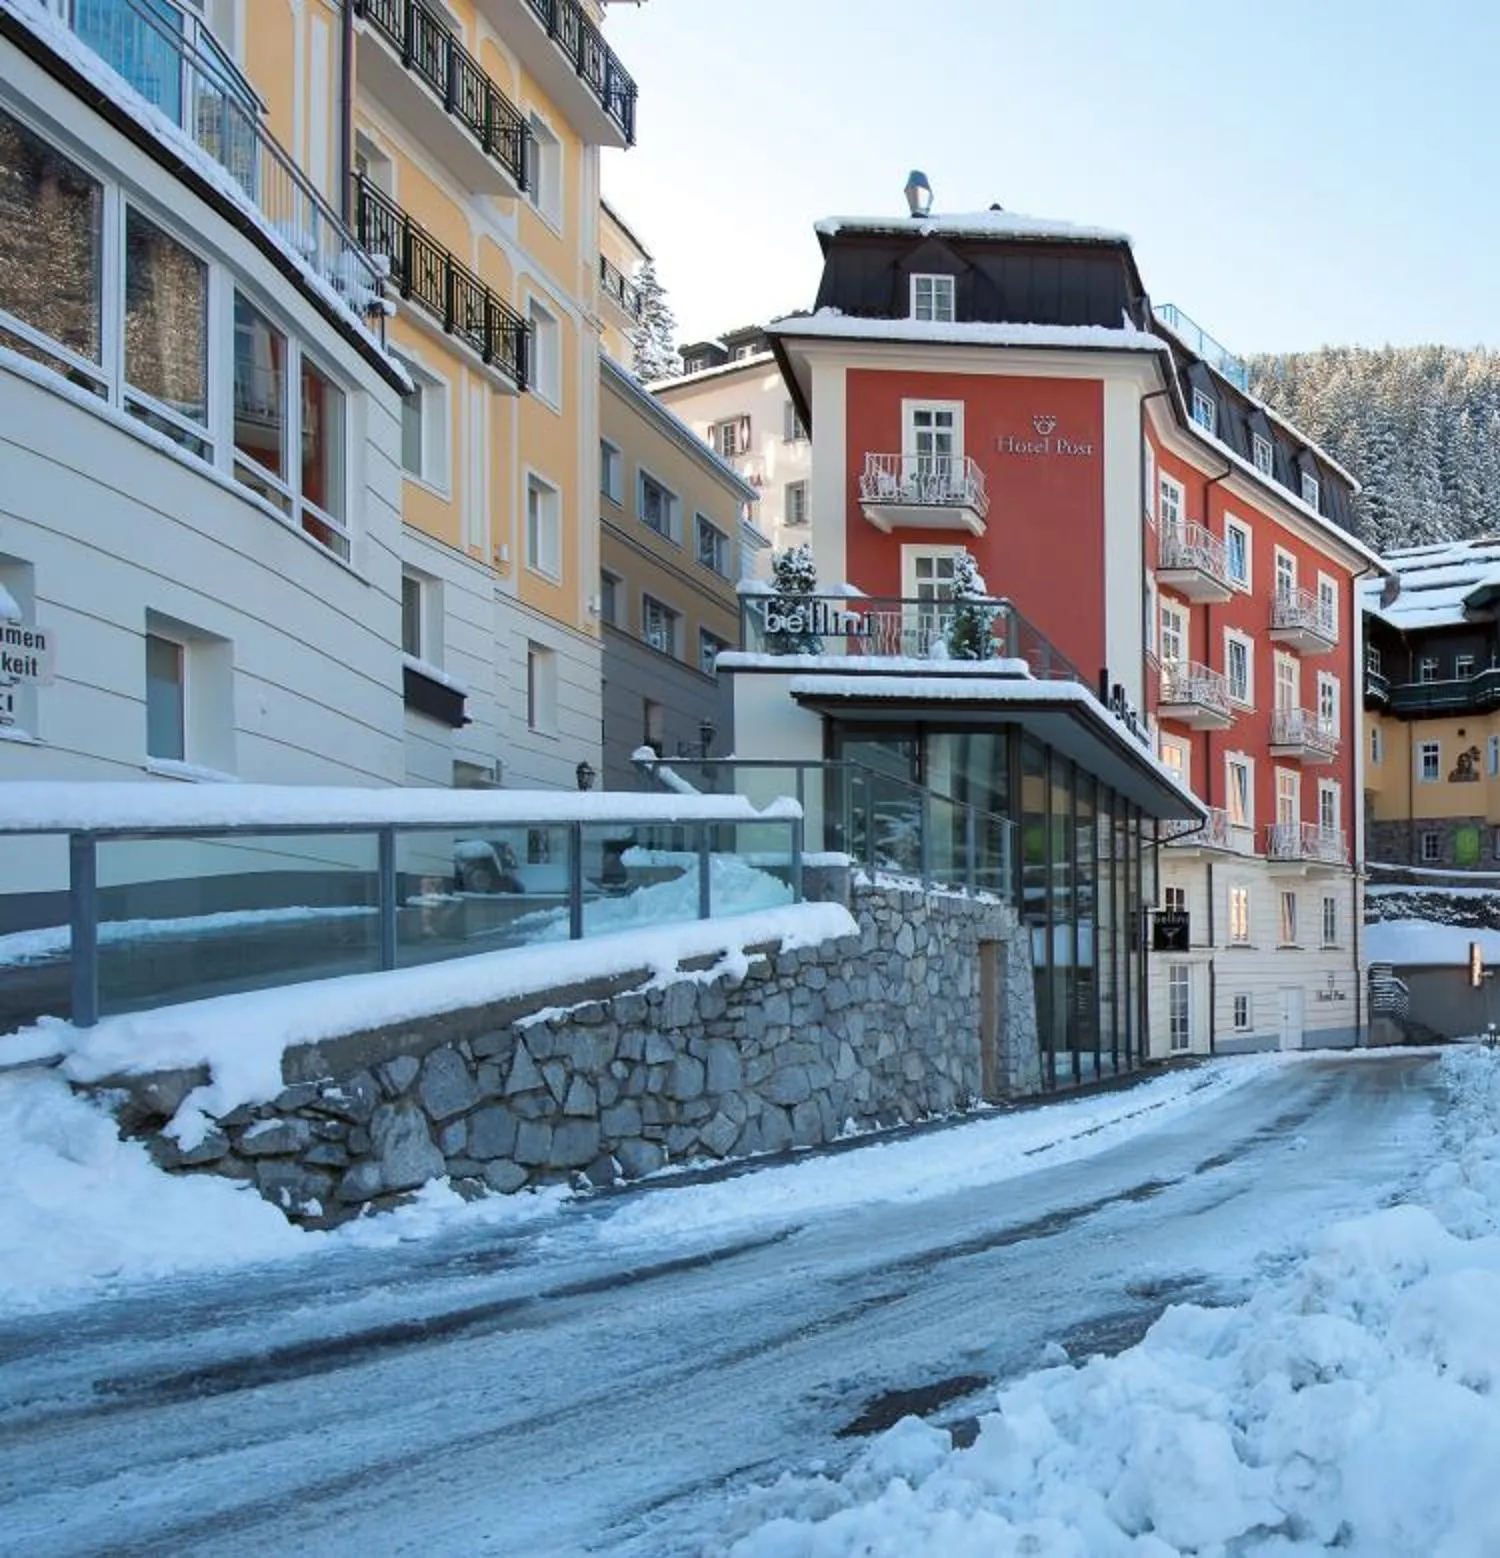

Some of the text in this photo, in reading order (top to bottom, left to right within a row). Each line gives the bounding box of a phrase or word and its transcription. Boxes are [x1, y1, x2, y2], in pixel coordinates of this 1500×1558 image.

[997, 435, 1093, 456] Hotel Post
[764, 600, 872, 635] bellini
